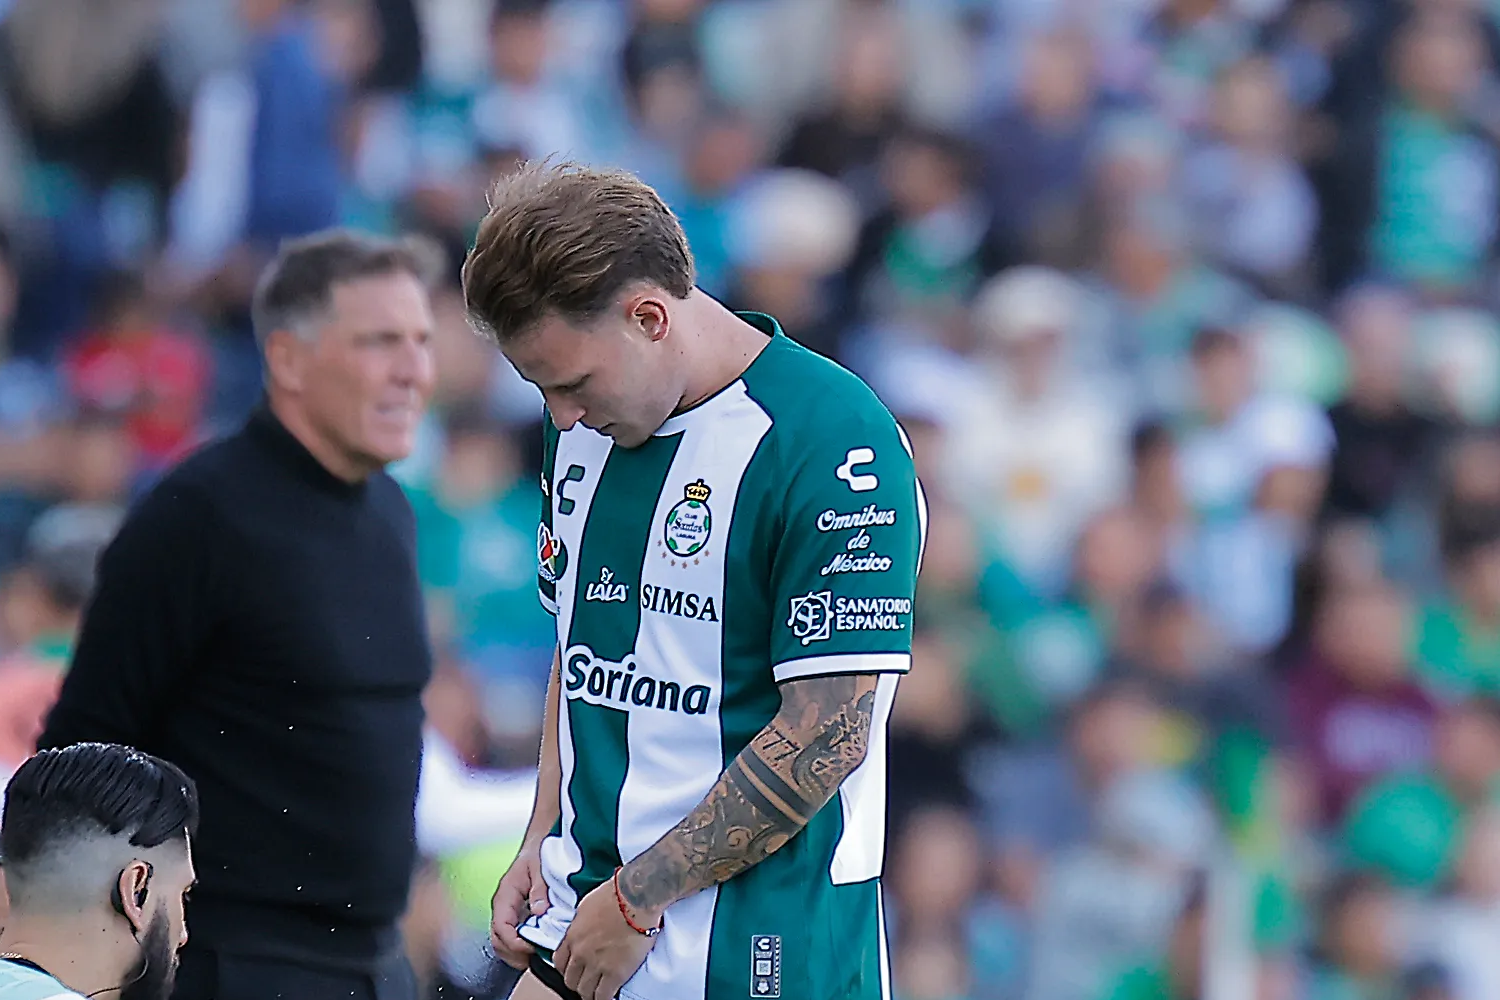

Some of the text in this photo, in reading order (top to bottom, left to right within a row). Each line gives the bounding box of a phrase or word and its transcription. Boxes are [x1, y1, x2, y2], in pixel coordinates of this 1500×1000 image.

[817, 504, 896, 532] Omnibus
[847, 529, 871, 550] de
[821, 552, 893, 576] México
[641, 583, 719, 622] SIMSA
[835, 598, 911, 616] SANATORIO
[566, 653, 712, 715] Soriana
